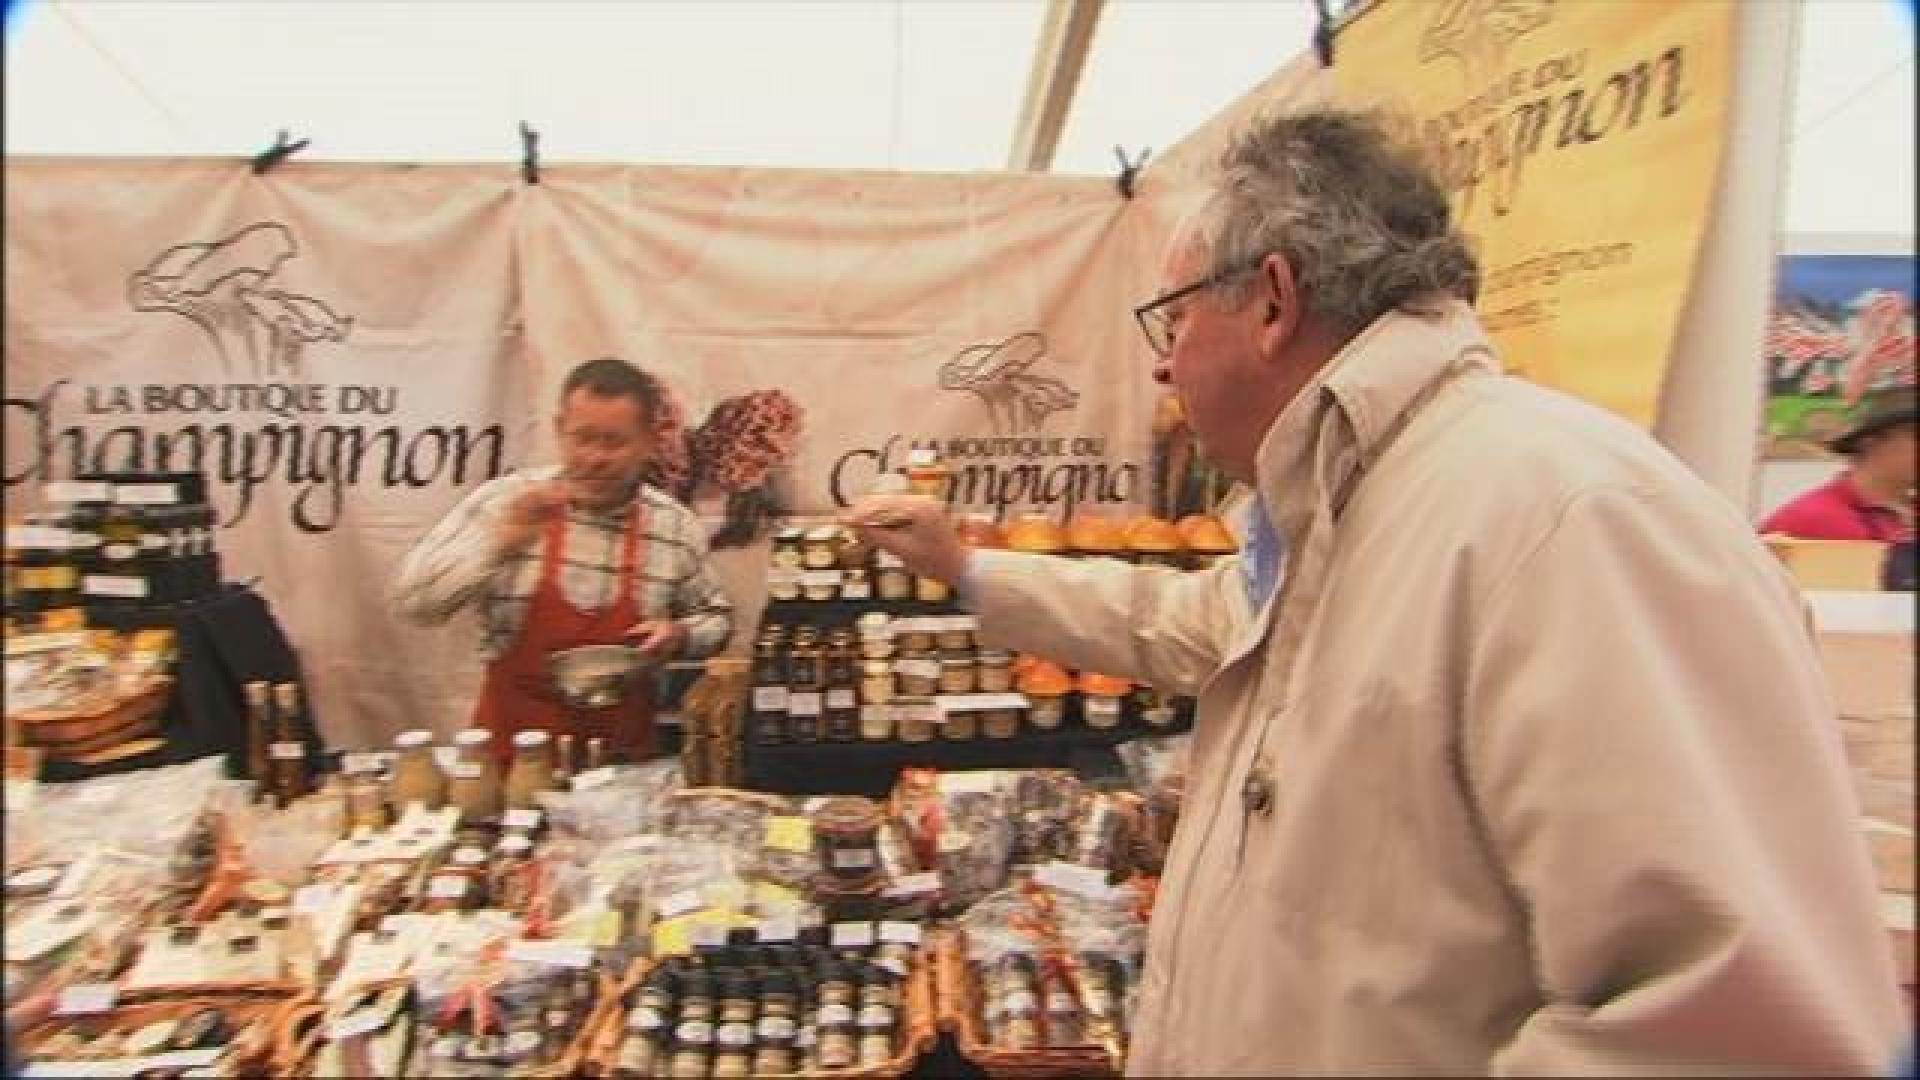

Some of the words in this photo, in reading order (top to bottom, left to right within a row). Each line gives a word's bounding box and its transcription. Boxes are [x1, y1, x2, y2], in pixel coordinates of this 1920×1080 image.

[84, 385, 134, 414] LA
[144, 384, 327, 417] BOUTIQUE
[338, 384, 400, 415] DU
[946, 437, 1067, 458] BOUTIQUE
[1071, 437, 1104, 457] DU
